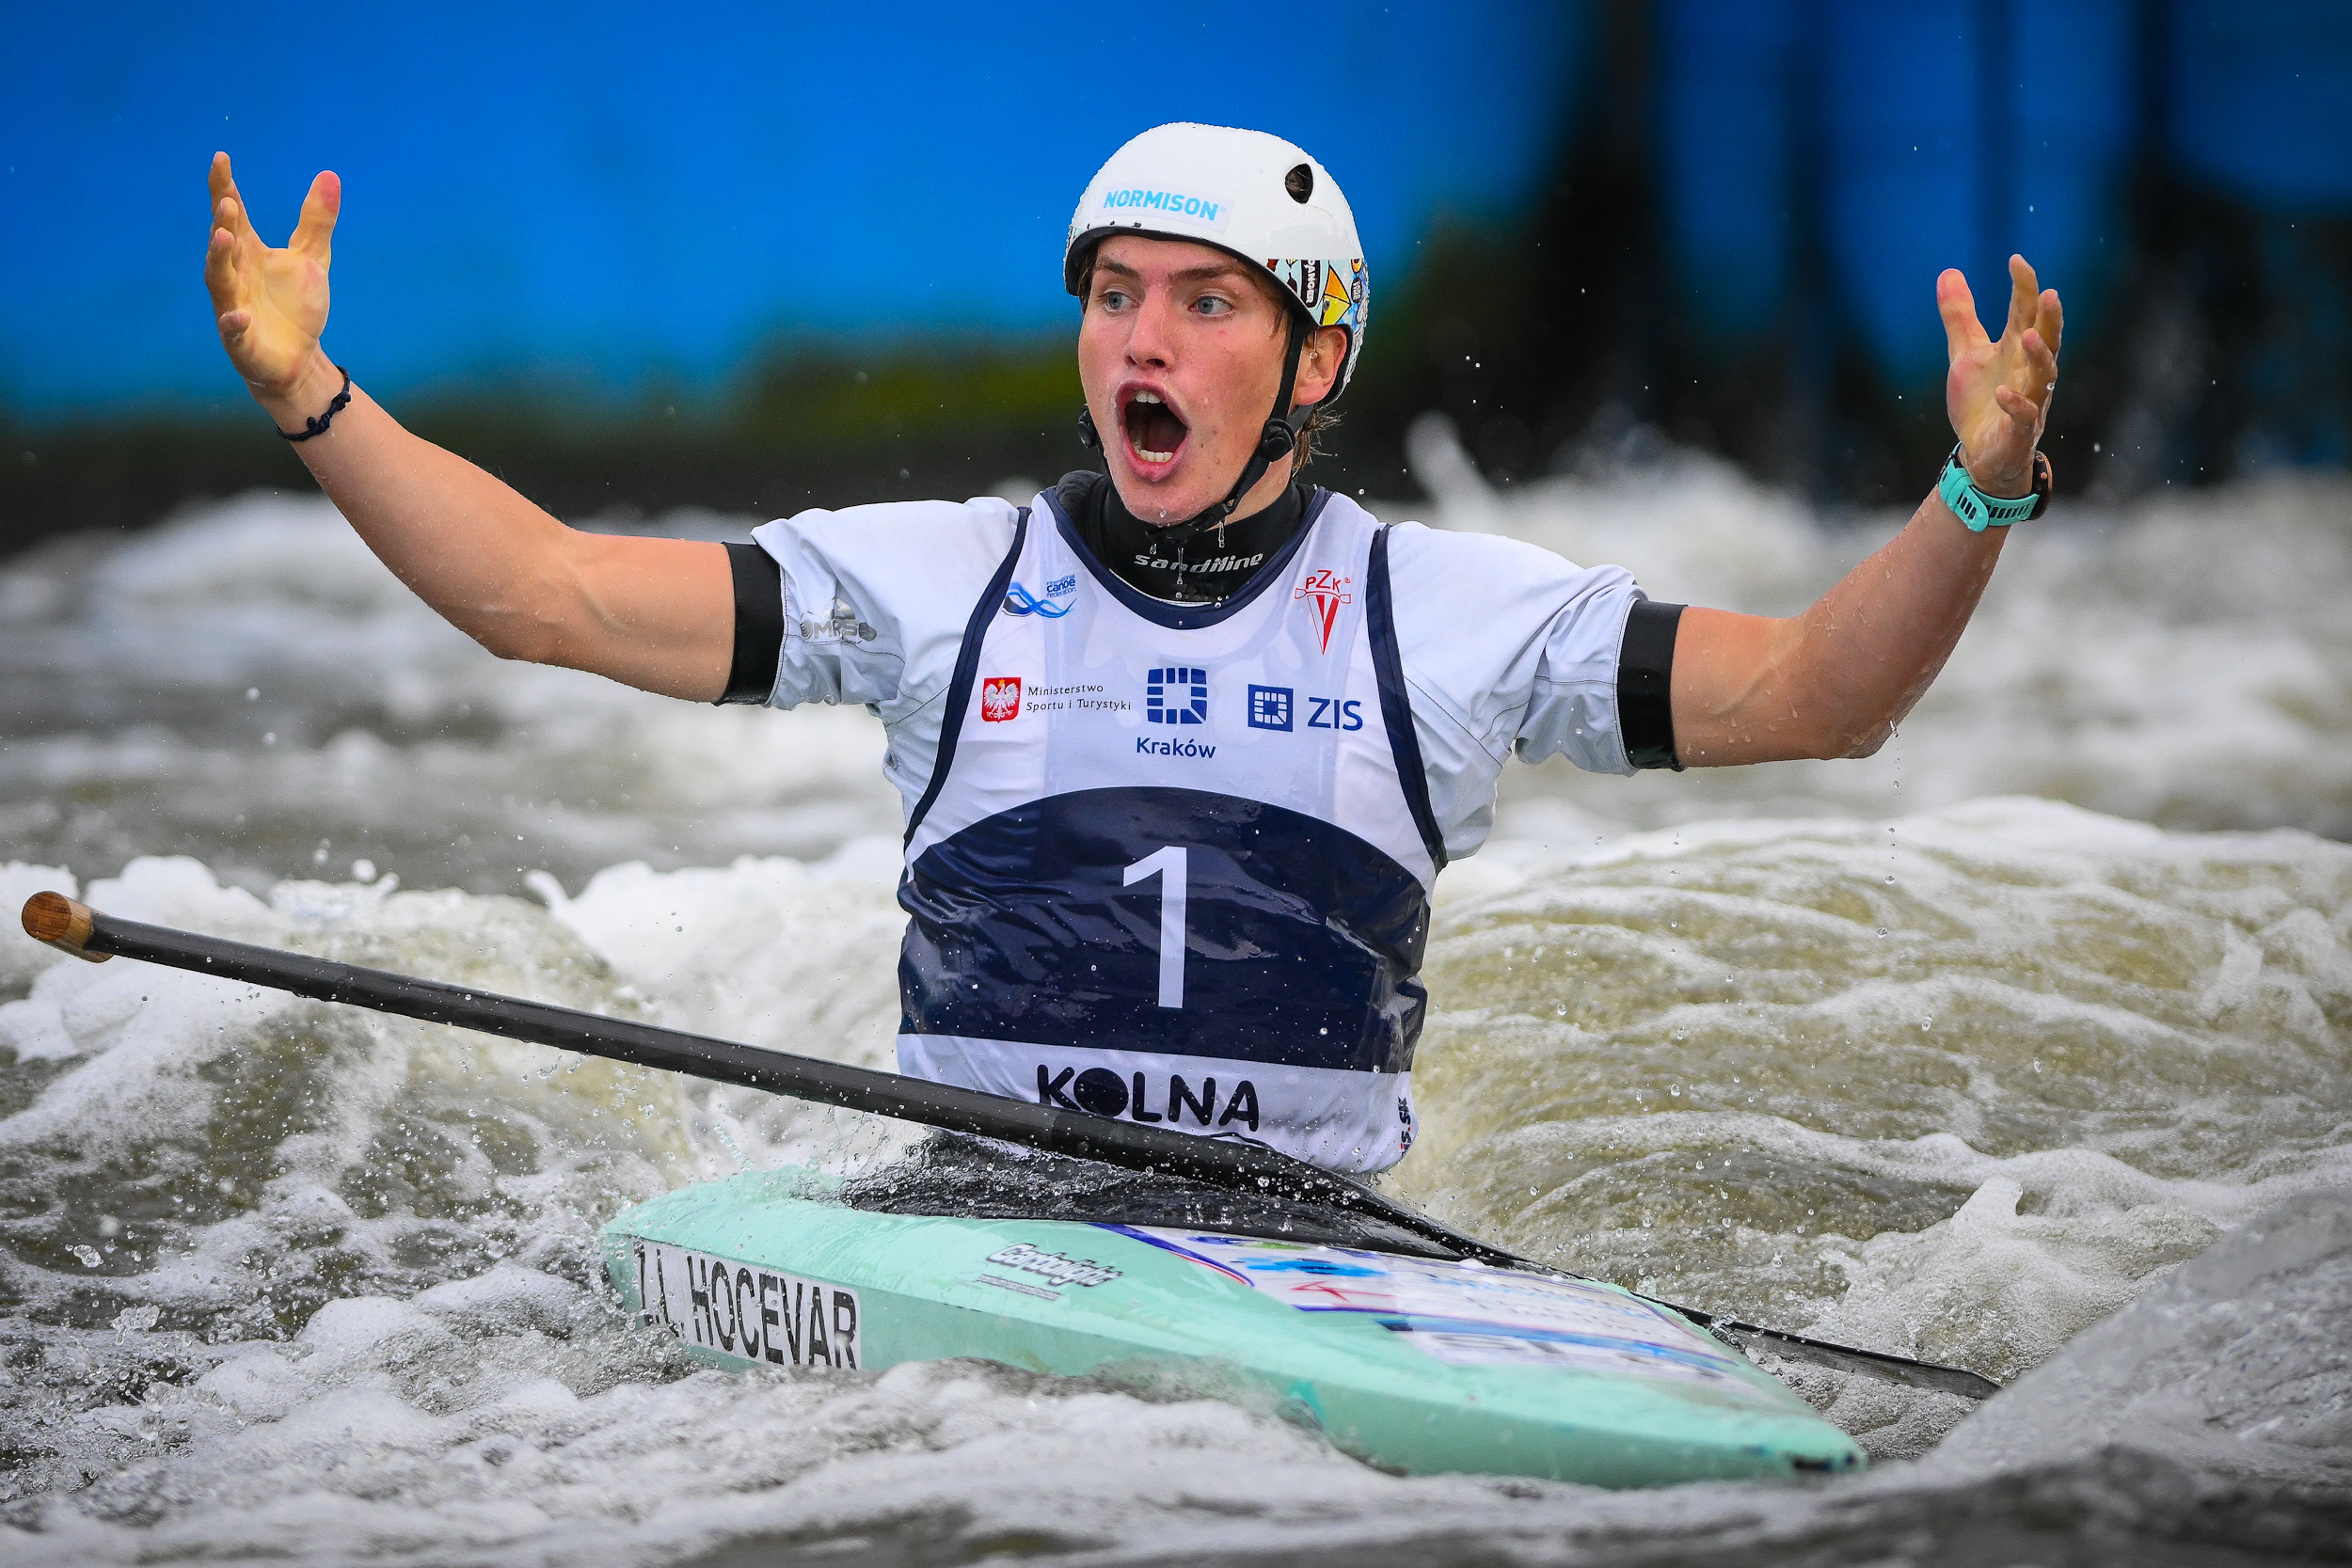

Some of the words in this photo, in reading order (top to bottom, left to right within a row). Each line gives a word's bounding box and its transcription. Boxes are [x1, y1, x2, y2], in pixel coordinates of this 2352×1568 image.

[1103, 190, 1219, 221] NORMISON
[1026, 702, 1064, 713] Sportu
[1069, 699, 1073, 709] i
[1076, 698, 1131, 711] Turystyki
[1027, 685, 1104, 696] Ministerstwo
[1307, 696, 1363, 731] ZIS
[1136, 736, 1216, 759] Kraków
[1122, 846, 1187, 1009] 1
[1037, 1064, 1260, 1132] KOLNA
[687, 1255, 857, 1370] HOCEVAR
